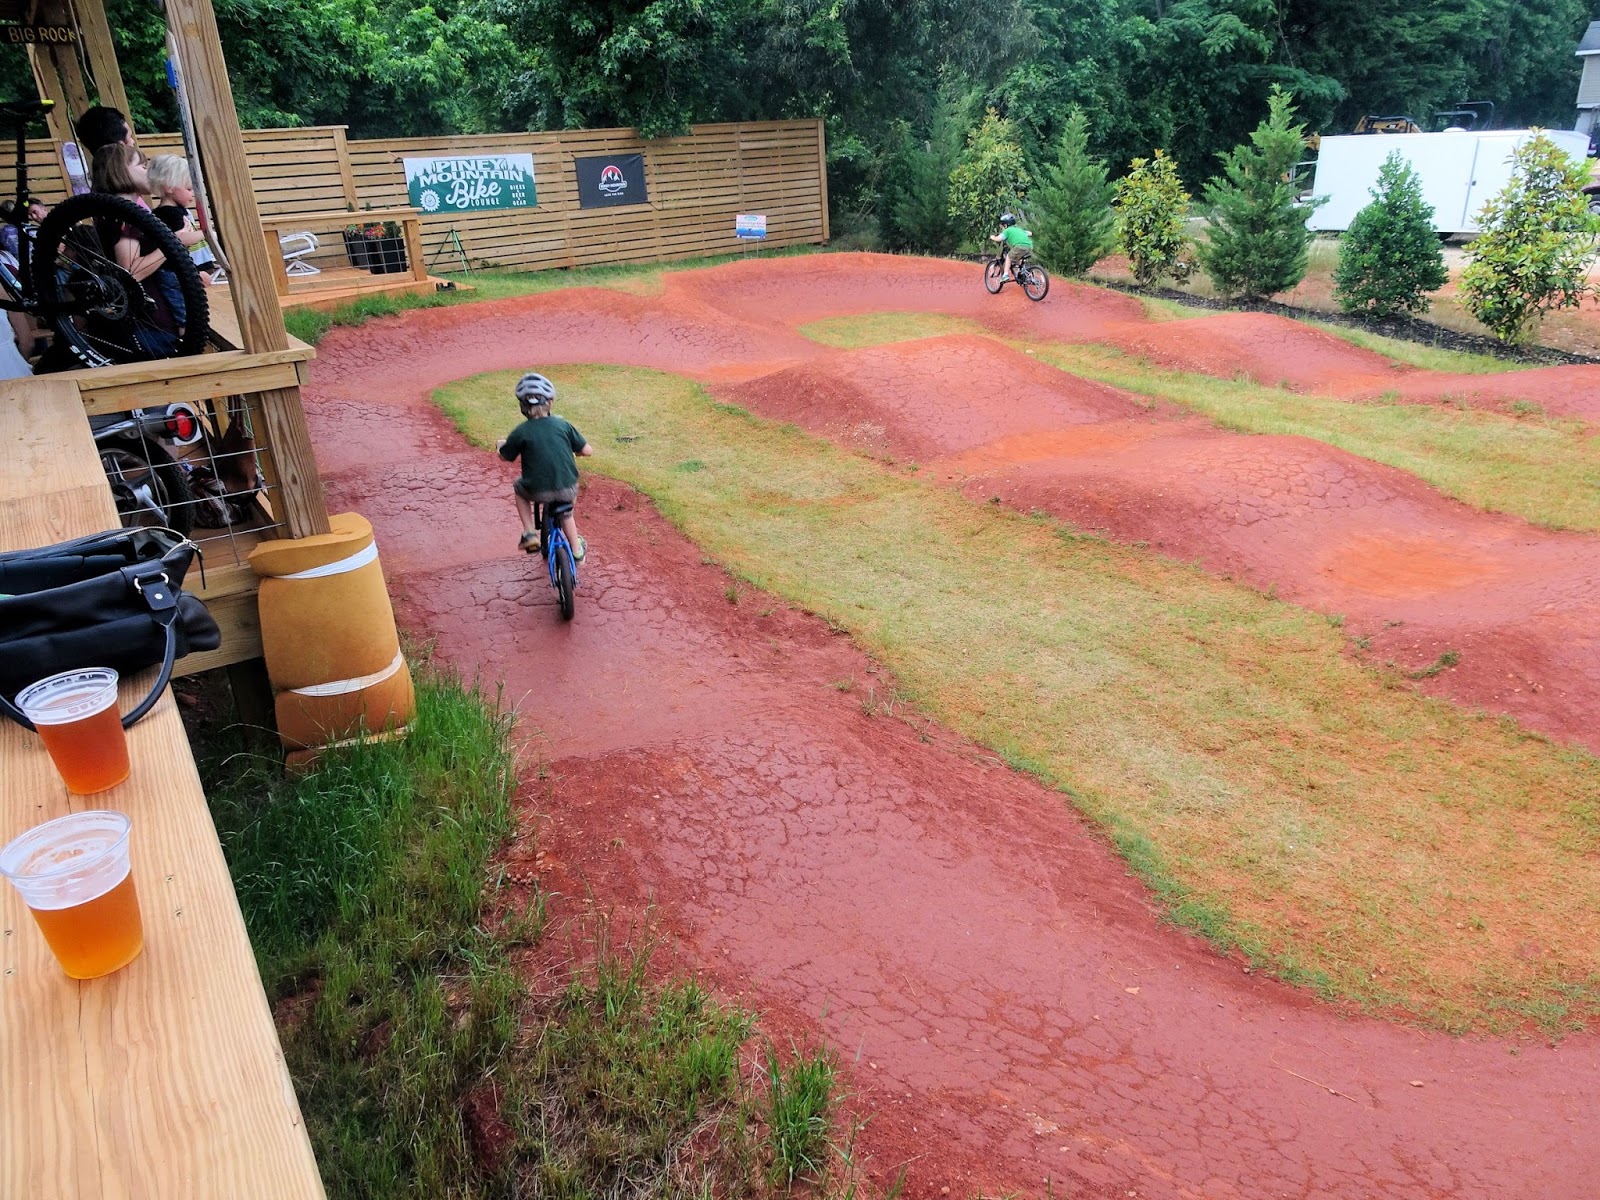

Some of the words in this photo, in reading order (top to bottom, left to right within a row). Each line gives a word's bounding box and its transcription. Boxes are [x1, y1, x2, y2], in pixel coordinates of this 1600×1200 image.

[8, 26, 36, 42] BIG
[38, 27, 76, 42] ROCK
[435, 159, 505, 174] PINEY
[419, 170, 524, 188] MOUNTAIN
[445, 175, 502, 209] Bike
[470, 197, 500, 207] LOUNGE
